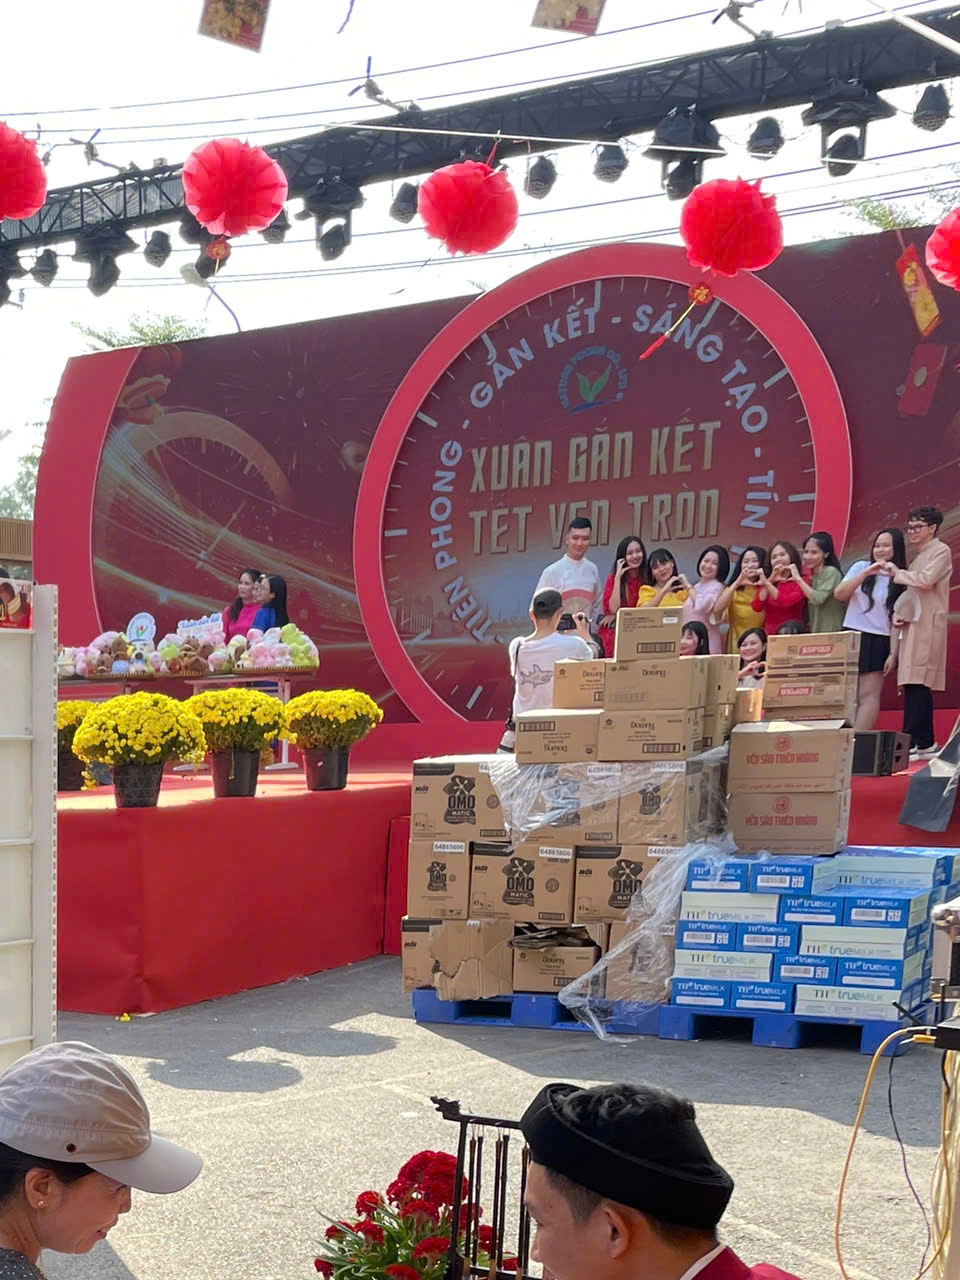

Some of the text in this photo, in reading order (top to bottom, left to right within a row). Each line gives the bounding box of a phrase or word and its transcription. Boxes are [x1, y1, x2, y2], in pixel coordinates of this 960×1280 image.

[542, 298, 600, 349] KẾT
[632, 302, 768, 433] SÁNG TẠO
[470, 408, 721, 493] XUÂN GẮN KẾT
[430, 439, 463, 570] PHONG
[468, 493, 533, 556] TẾT
[627, 482, 720, 543] TRÒN
[740, 469, 779, 529] TÍN
[448, 794, 476, 811] OMO
[506, 876, 535, 892] OMO
